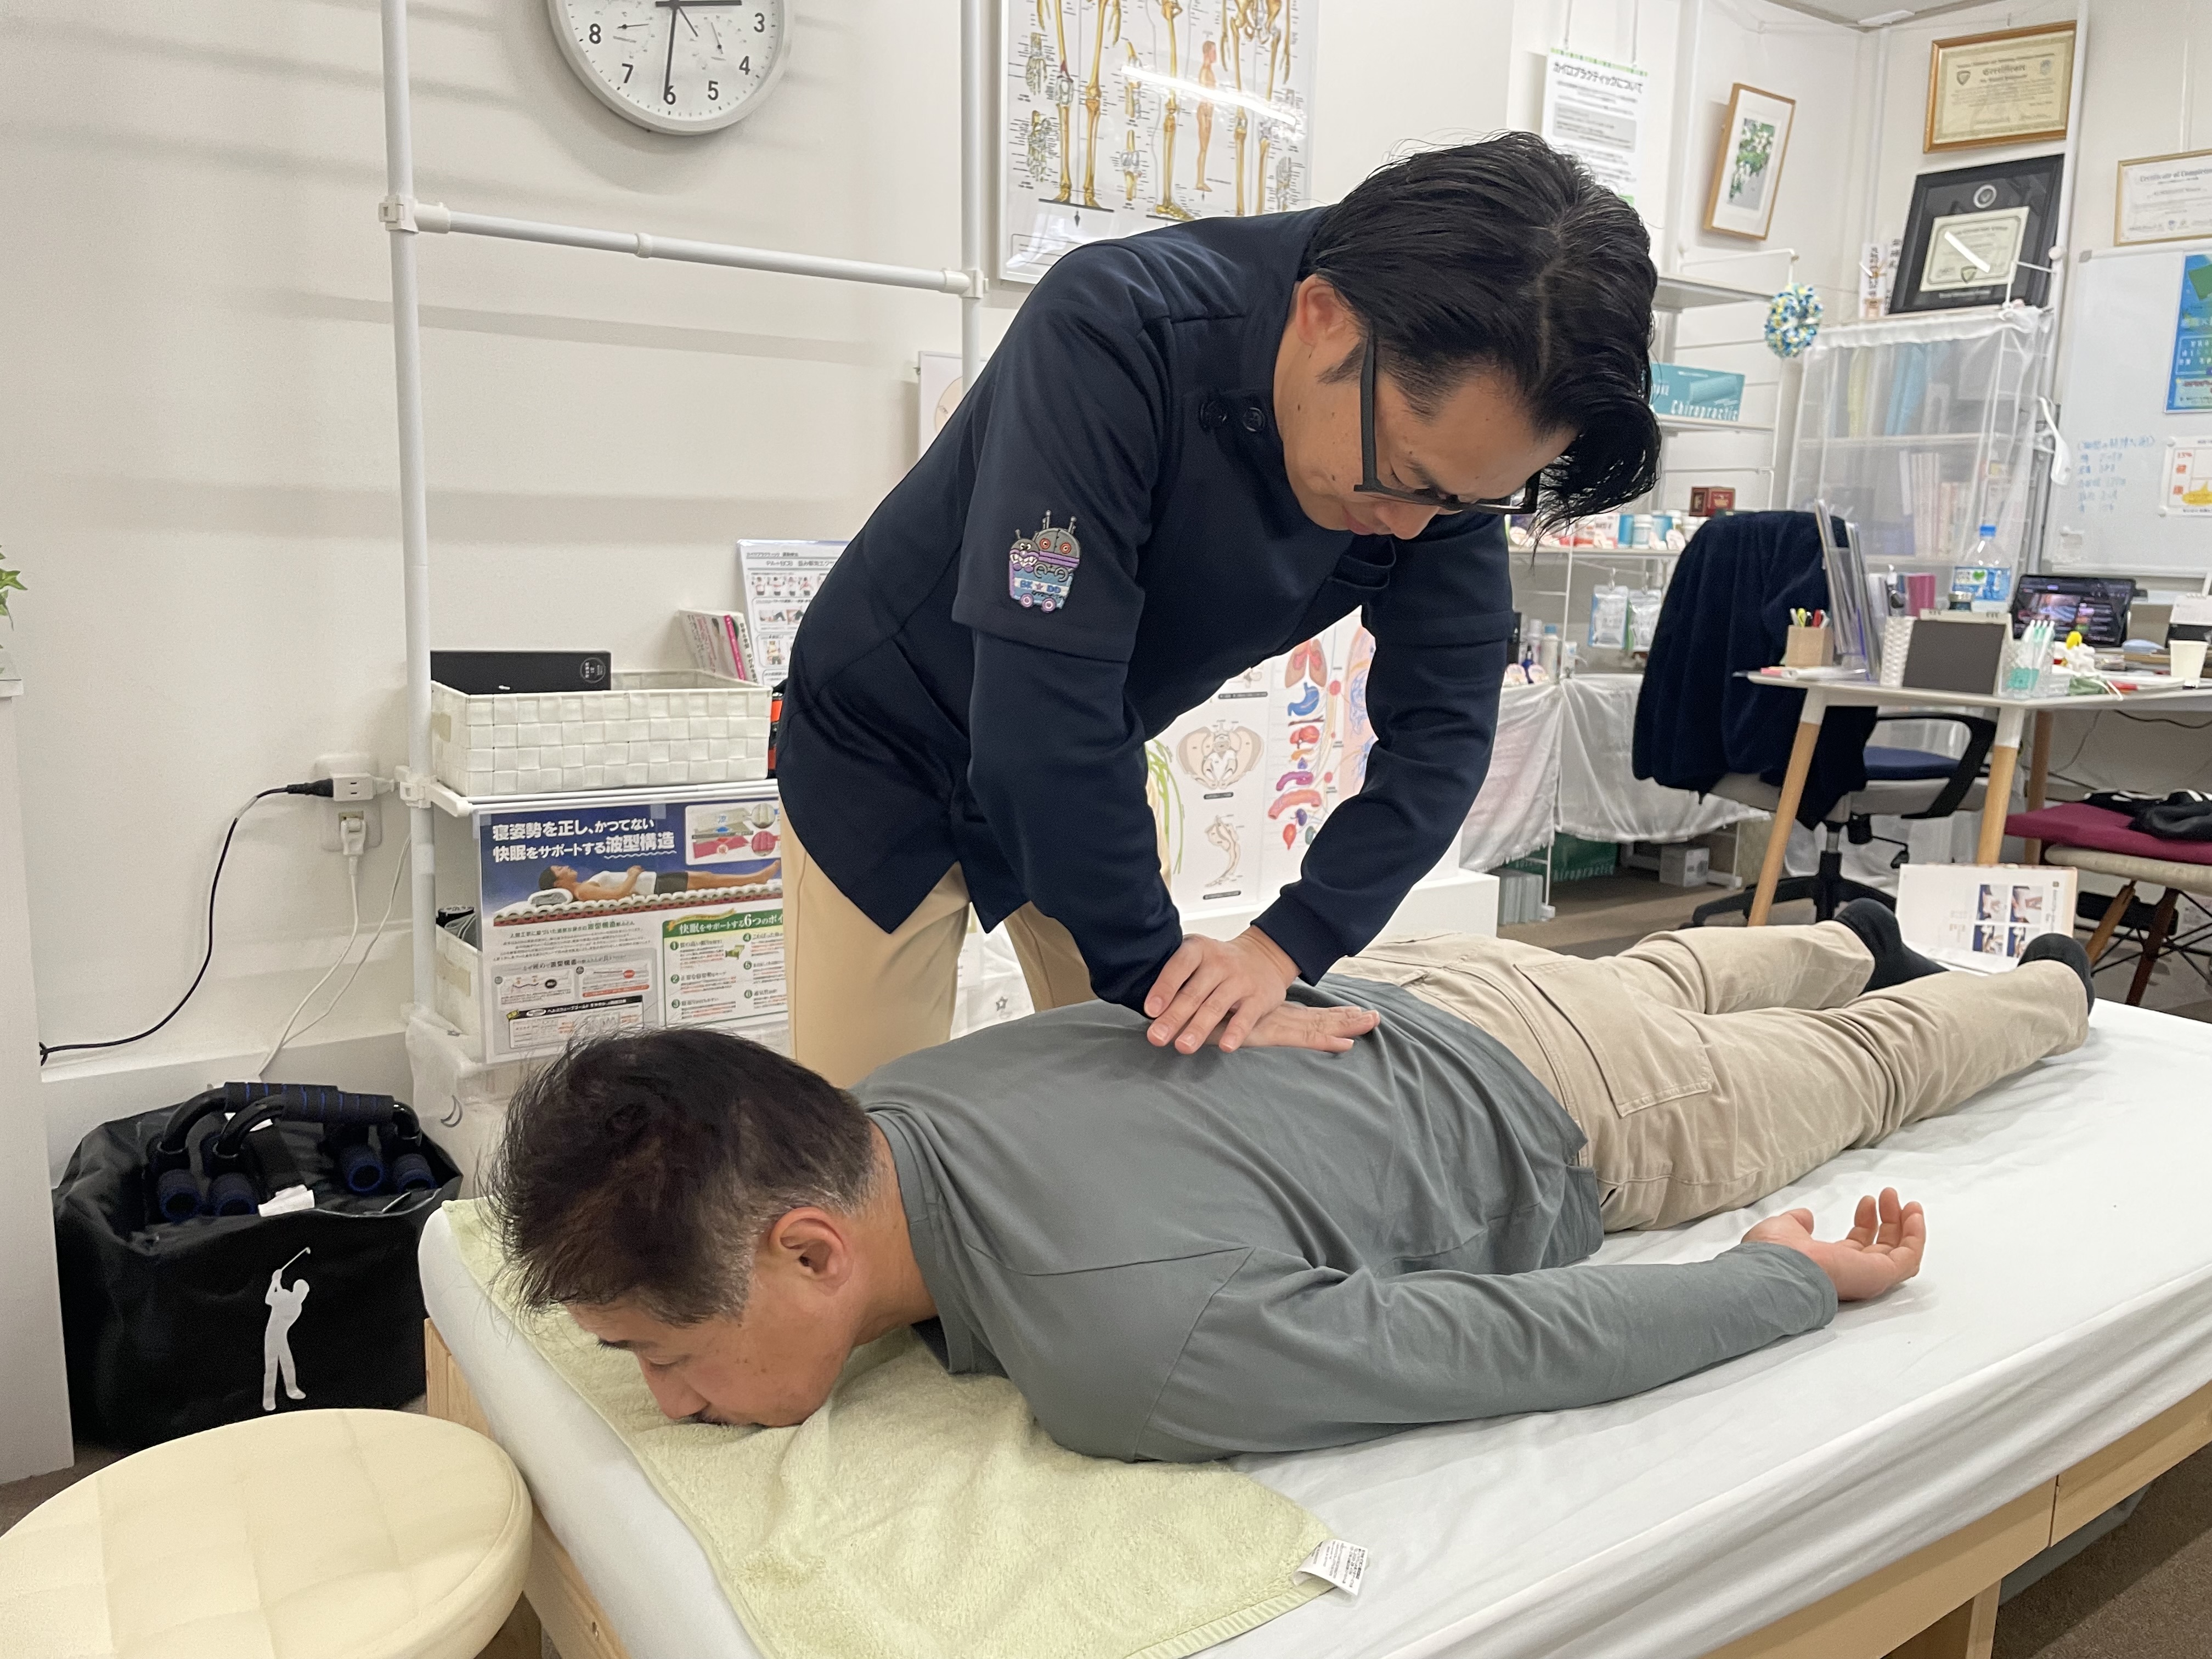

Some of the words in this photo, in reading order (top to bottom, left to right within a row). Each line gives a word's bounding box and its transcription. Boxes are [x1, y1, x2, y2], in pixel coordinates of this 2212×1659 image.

[754, 13, 765, 32] 3
[589, 24, 602, 44] 8
[622, 63, 633, 83] 7
[738, 56, 751, 75] 4
[664, 86, 676, 105] 6
[707, 81, 719, 100] 5
[493, 818, 655, 841] 寝姿勢を正し、かつてない
[493, 832, 675, 862] 快眠をサポートする波型構造
